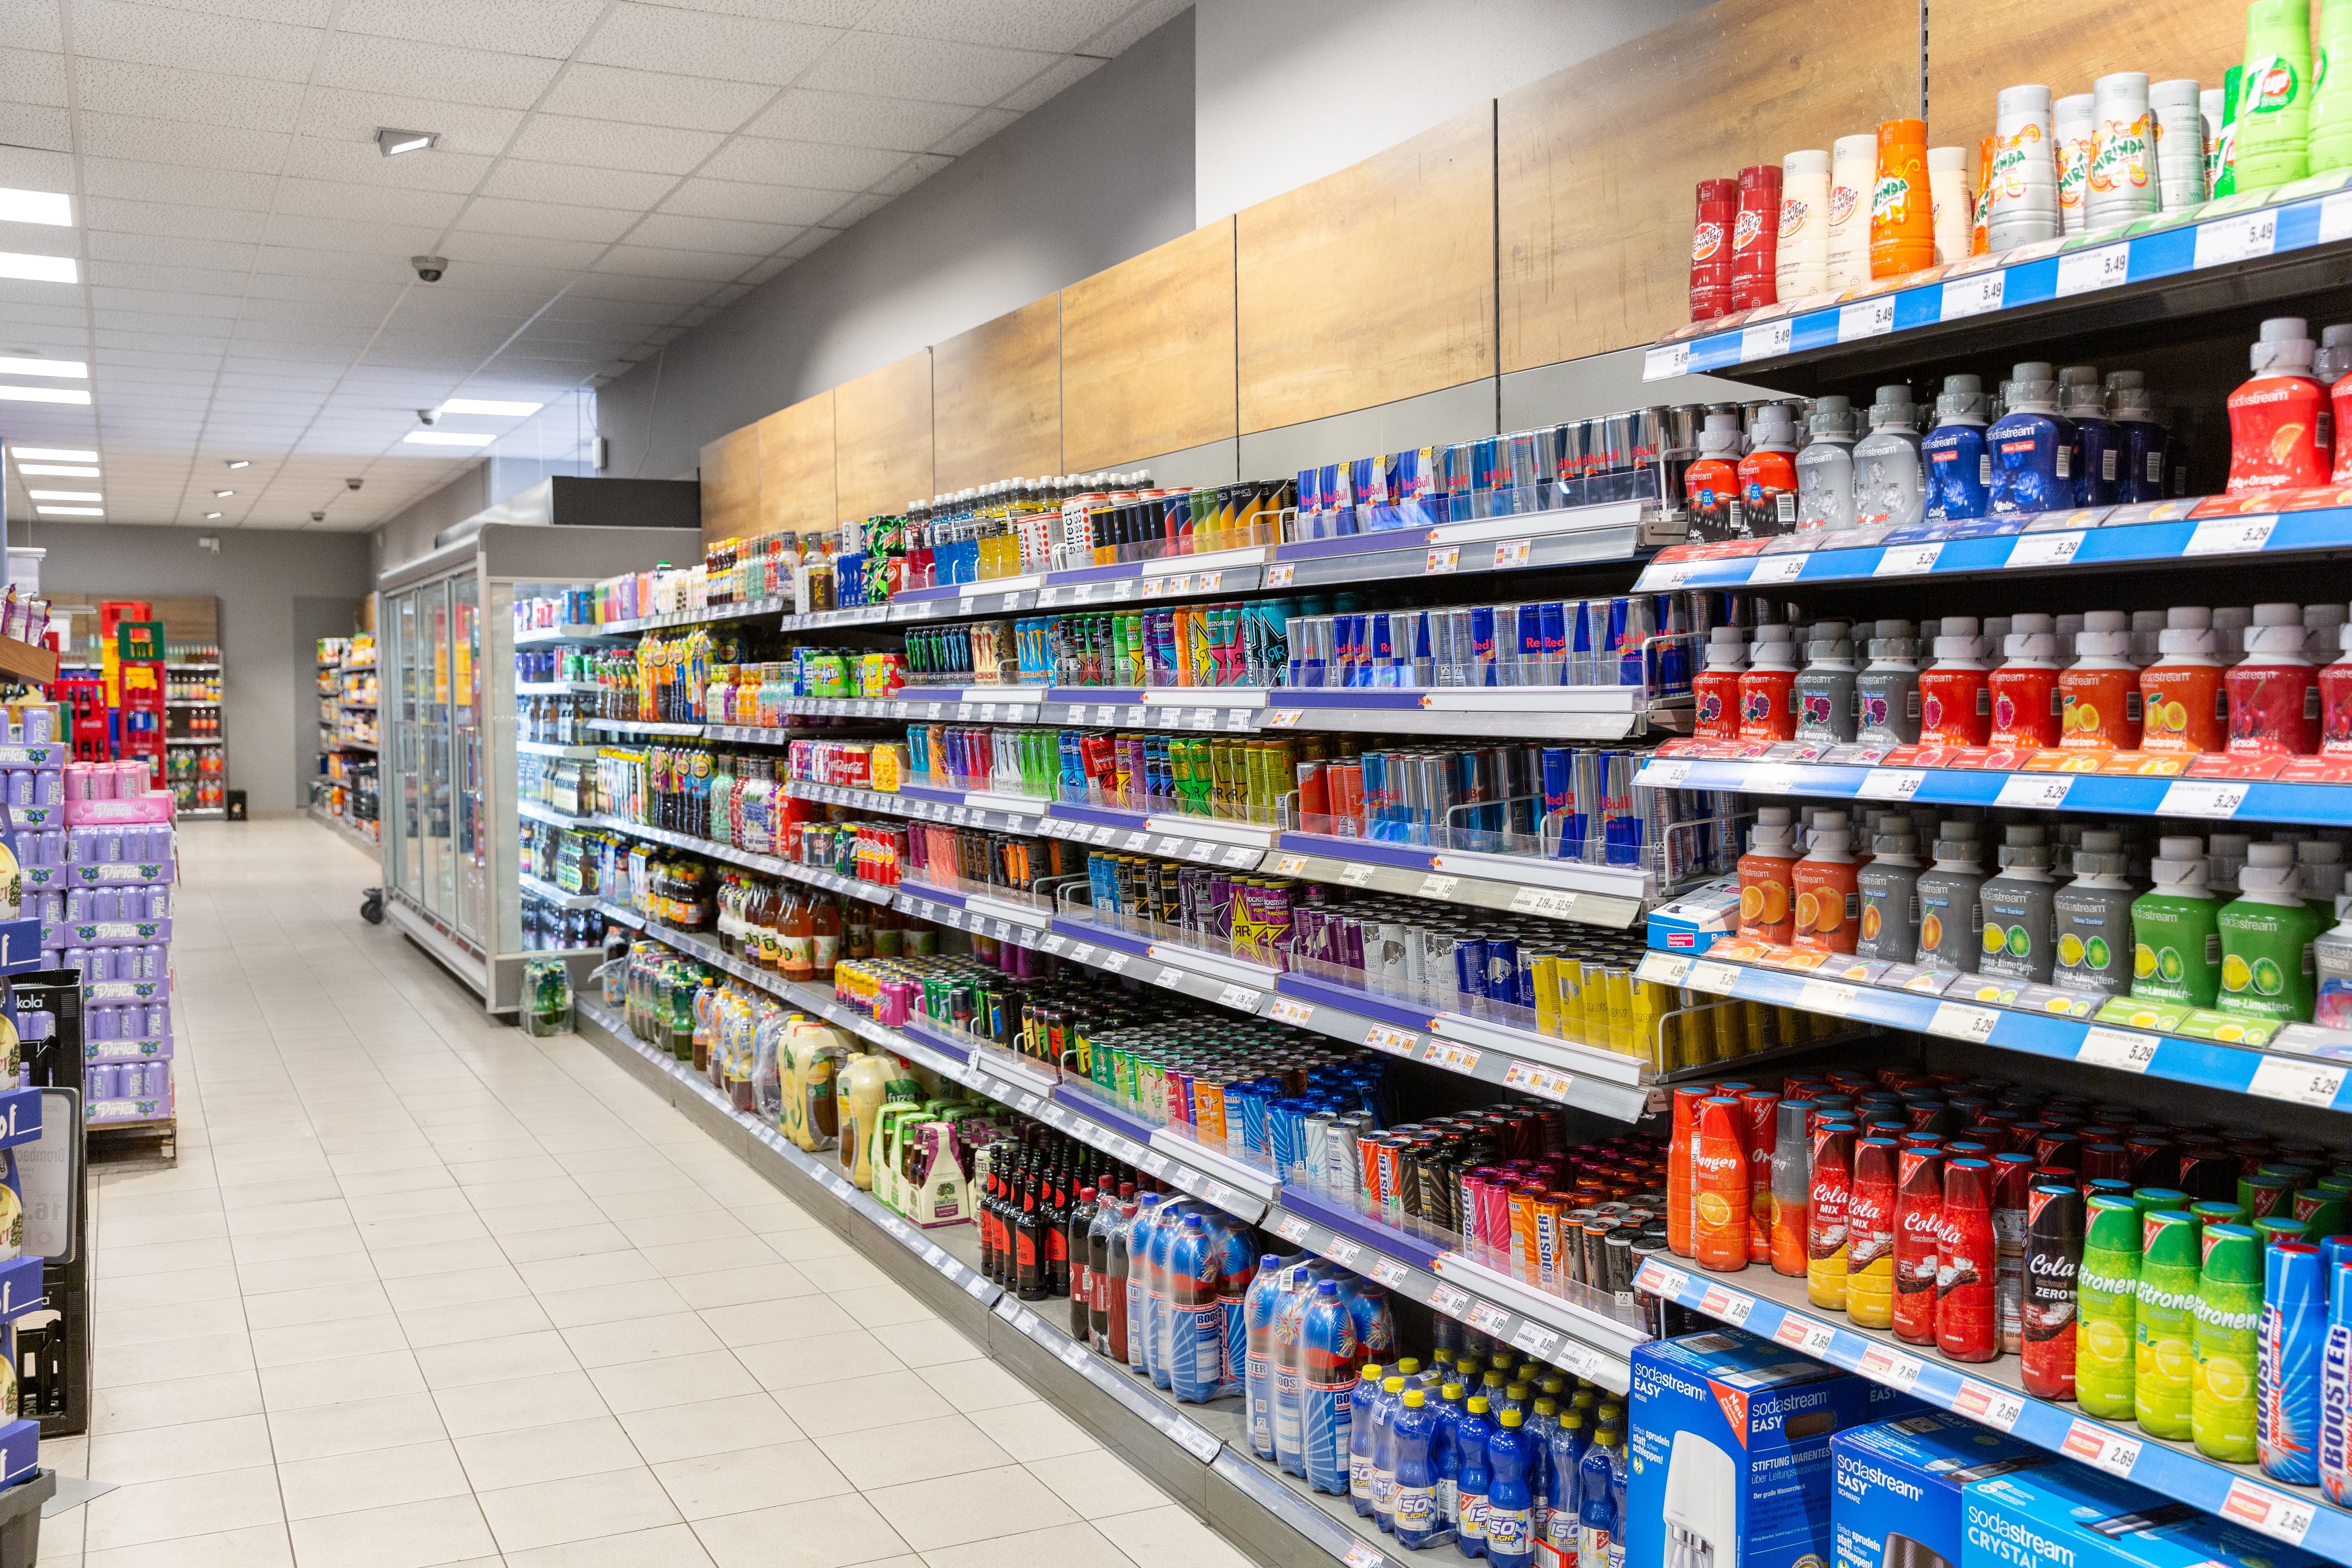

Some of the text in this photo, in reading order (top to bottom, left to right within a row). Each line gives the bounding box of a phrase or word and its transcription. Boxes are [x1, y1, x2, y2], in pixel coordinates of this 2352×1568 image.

[2261, 96, 2288, 107] free
[2091, 135, 2145, 175] MIRINDA
[2249, 222, 2273, 244] 5.49
[2104, 255, 2126, 274] 5.49
[1983, 282, 2002, 300] 5.49
[1875, 306, 1893, 324] 5.49
[1774, 328, 1790, 345] 5.49
[1674, 351, 1688, 366] 5.49
[2227, 390, 2289, 408] sodastream
[1986, 425, 2035, 441] sodastream
[1853, 446, 1898, 458] sodastream
[2015, 442, 2033, 451] Zucker
[1795, 454, 1833, 466] sodastream
[1942, 452, 1956, 460] Zucker
[1358, 482, 1383, 497] Red Bull
[1402, 474, 1430, 491] Red Bull
[1301, 495, 1314, 506] Red
[1323, 488, 1348, 502] Red Bull
[2242, 527, 2270, 542] 5.29
[2054, 542, 2078, 556] 5.29
[1916, 552, 1937, 565] 5.29
[1785, 563, 1803, 574] 5.29
[1545, 636, 1565, 648] Red
[1623, 632, 1645, 644] Bull
[2140, 672, 2190, 683] sodastream
[1747, 726, 1769, 735] Beeren-
[1804, 729, 1830, 740] Beeren-
[1095, 756, 1114, 764] PUNCHED
[1670, 770, 1685, 780] 5.29
[1898, 780, 1918, 793] 5.29
[2043, 786, 2067, 799] 5.29
[2213, 794, 2240, 809] 5.29
[100, 863, 141, 881] DirTea
[1341, 871, 1370, 883] EINWEG 1.69
[1422, 882, 1453, 895] EINWEG 1.69
[1513, 896, 1572, 913] EINWEG 2.19 52.56
[2006, 908, 2025, 916] Zucker
[2056, 900, 2106, 913] sodastream
[95, 922, 139, 941] DirTea
[1740, 926, 1760, 935] Orangen-
[2220, 917, 2278, 932] sodastream
[1795, 934, 1816, 943] Orangen-
[1670, 965, 1685, 978] 4.99
[1983, 966, 2014, 976] Geschmack
[1719, 973, 1737, 987] 5.29
[2060, 979, 2093, 991] Geschmack
[95, 980, 136, 1001] DirTea
[1972, 1018, 1994, 1033] 5.29
[98, 1041, 140, 1058] DirTea
[2129, 1045, 2154, 1061] 5.29
[2310, 1076, 2339, 1094] 5.29
[95, 1100, 137, 1118] DirTea
[1813, 1184, 1848, 1203] Cola
[1820, 1204, 1839, 1214] MIX
[1849, 1196, 1880, 1219] Cola
[1817, 1213, 1842, 1224] Geschmack
[1851, 1218, 1868, 1229] MIX
[1296, 1227, 1307, 1238] 0.69
[1345, 1250, 1357, 1262] 0.69
[2030, 1253, 2074, 1278] Cola
[1391, 1271, 1404, 1283] 0.69
[2035, 1277, 2067, 1288] Geschmack
[1669, 1278, 1684, 1293] 2.69
[2035, 1287, 2067, 1299] ZERO
[1452, 1298, 1464, 1311] 0.69
[1732, 1302, 1750, 1319] 2.69
[1491, 1317, 1504, 1329] 0.69
[1517, 1332, 1555, 1352] EINWEG 0.89
[1811, 1333, 1830, 1350] 2.69
[1560, 1351, 1580, 1365] EINWEG
[1898, 1365, 1917, 1384] 2.69
[2257, 1302, 2275, 1441] BOOSTER
[1634, 1377, 1661, 1398] EASY
[1635, 1363, 1703, 1402] sodastream
[1634, 1392, 1647, 1403] WEISS
[1752, 1391, 1827, 1417] sodastream
[2323, 1326, 2349, 1470] BOOSTER
[1728, 1392, 1744, 1420] Neu
[1996, 1403, 2018, 1423] 2.69
[1752, 1416, 1783, 1433] EASY
[1633, 1424, 1670, 1448] Einfach sprudeln
[1633, 1434, 1659, 1452] statt schwer
[1632, 1444, 1663, 1465] schleppen!
[2110, 1447, 2135, 1467] 2.69
[1752, 1455, 1790, 1472] STIFTUNG
[1751, 1472, 1767, 1485] über
[1837, 1454, 1920, 1502] sodastream
[1837, 1471, 1868, 1496] EASY
[1764, 1488, 1777, 1498] große
[1777, 1483, 1806, 1496] Wassercheck
[1837, 1487, 1860, 1505] SCHWARZ
[1397, 1498, 1428, 1513] ISO
[1405, 1512, 1429, 1520] LIGHT
[2280, 1510, 2308, 1533] 2.69
[1487, 1520, 1516, 1534] ISO
[1492, 1533, 1516, 1543] LIGHT
[1837, 1522, 1880, 1552] Einfach sprudeln
[1968, 1504, 2074, 1568] sodastream
[1837, 1533, 1867, 1557] statt schwer
